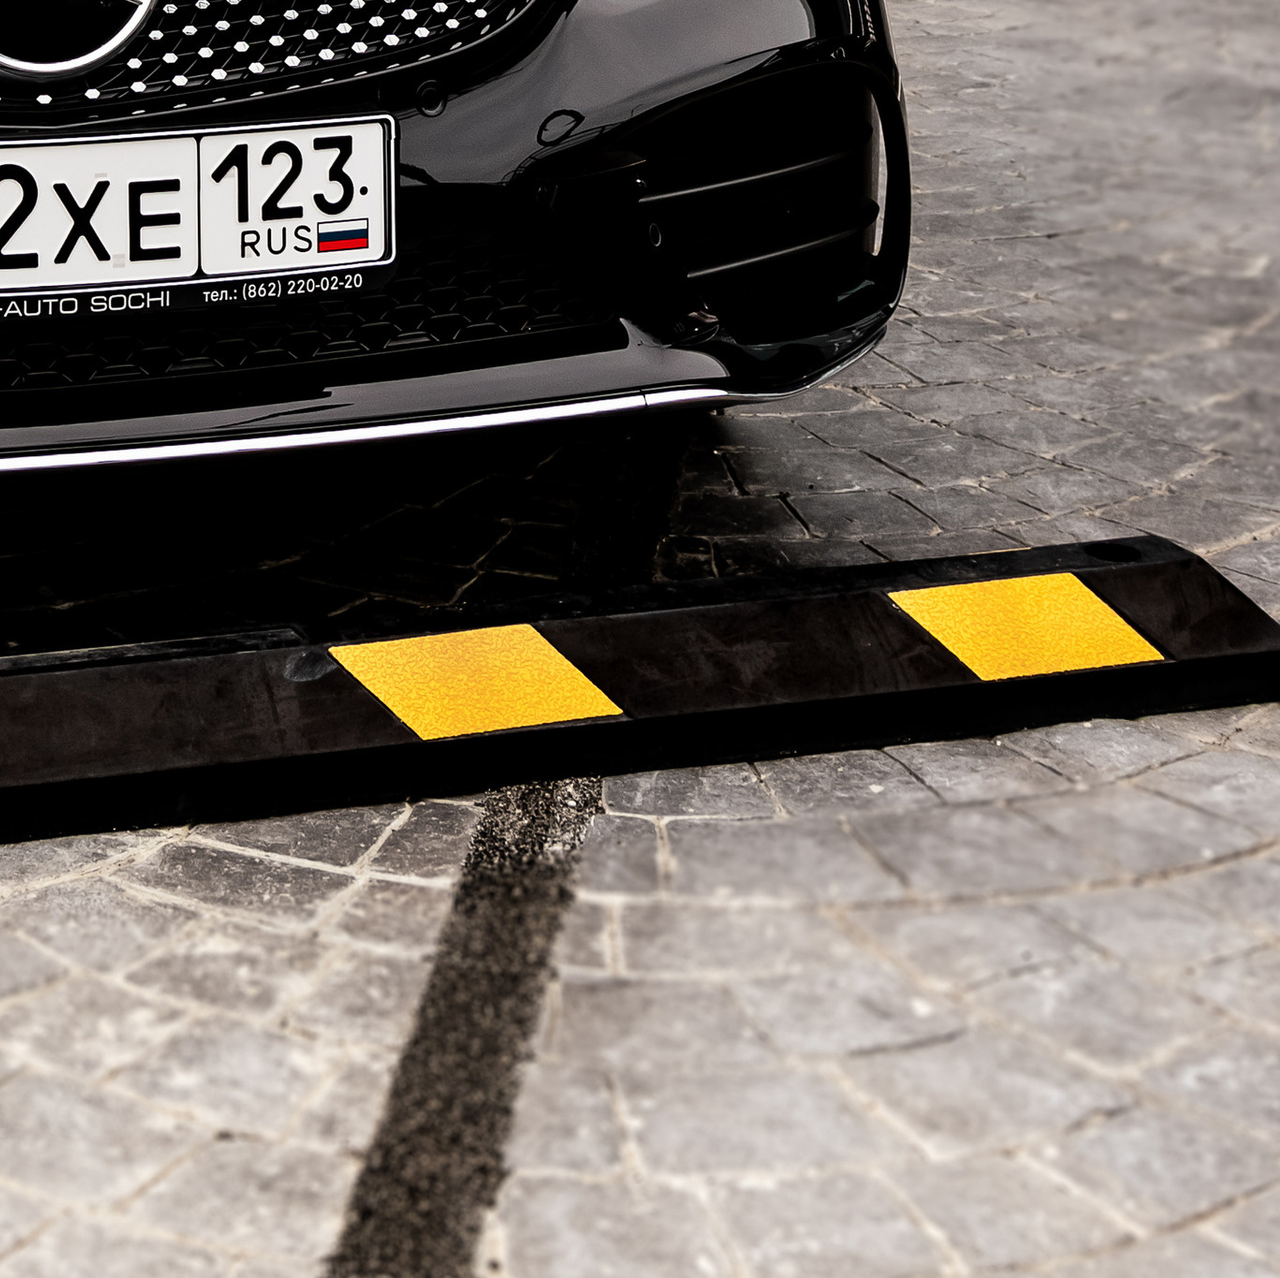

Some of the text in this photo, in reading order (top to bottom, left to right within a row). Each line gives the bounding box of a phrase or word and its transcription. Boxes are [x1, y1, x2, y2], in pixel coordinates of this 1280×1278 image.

[211, 135, 356, 222] 123
[240, 225, 312, 258] RUS
[90, 291, 170, 313] SOCHI
[203, 273, 363, 303] тел.: (862) 220-02-20
